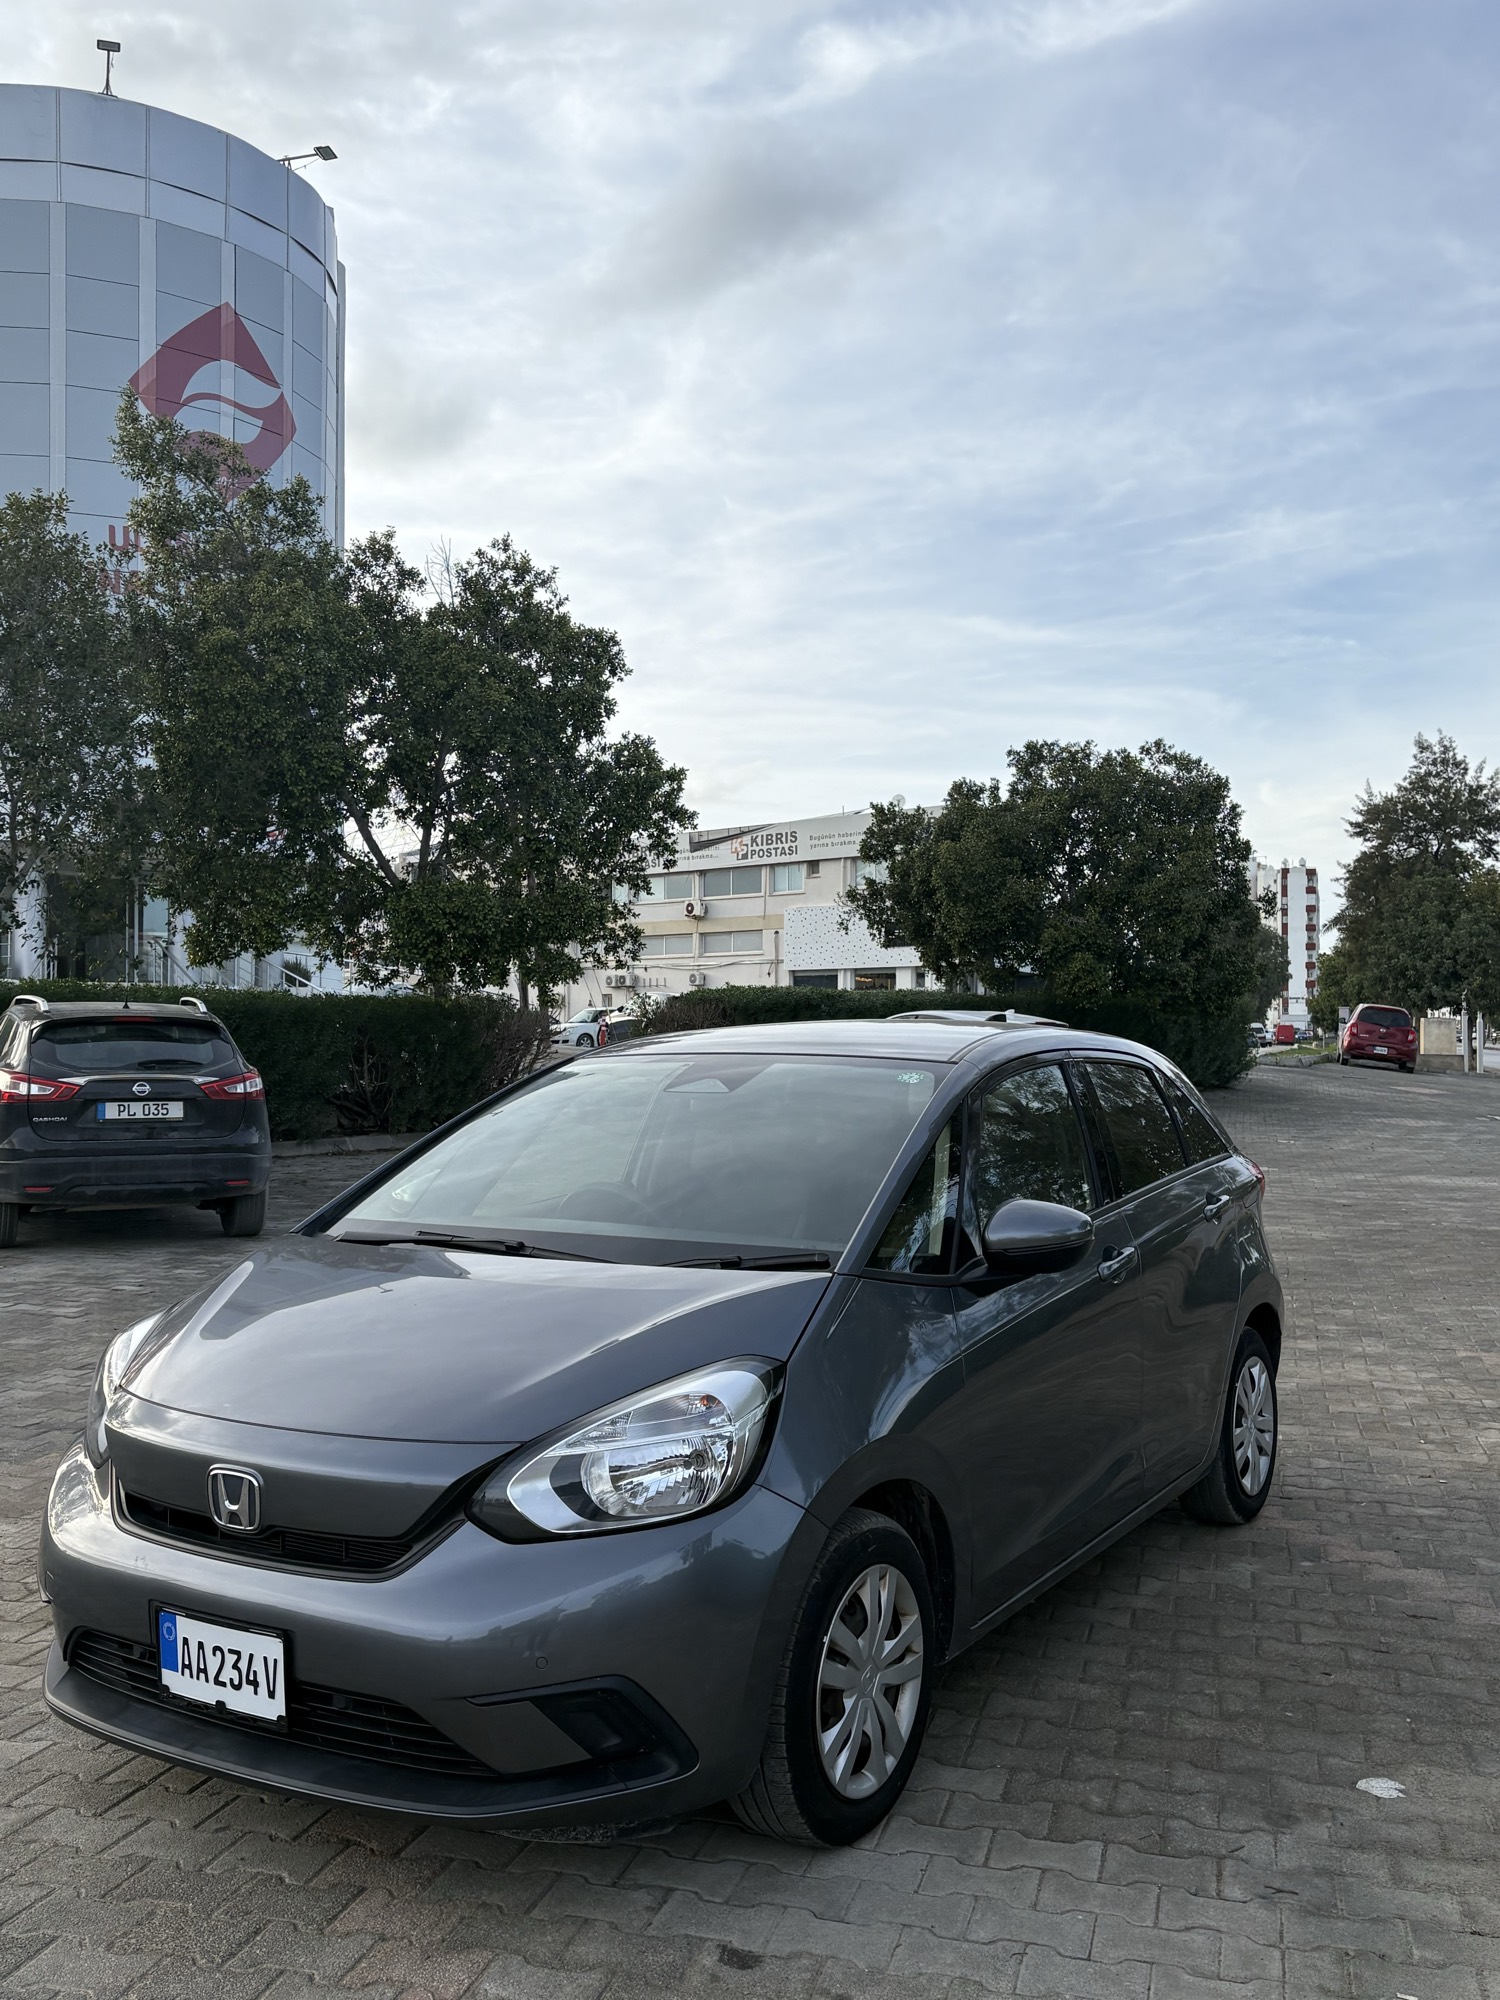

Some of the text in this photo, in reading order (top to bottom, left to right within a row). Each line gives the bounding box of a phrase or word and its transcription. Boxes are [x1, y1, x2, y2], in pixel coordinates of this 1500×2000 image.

[750, 830, 798, 847] KIBRIS
[750, 845, 798, 860] POSTASI
[117, 1103, 169, 1117] PL 035
[180, 1636, 278, 1700] AA234V
